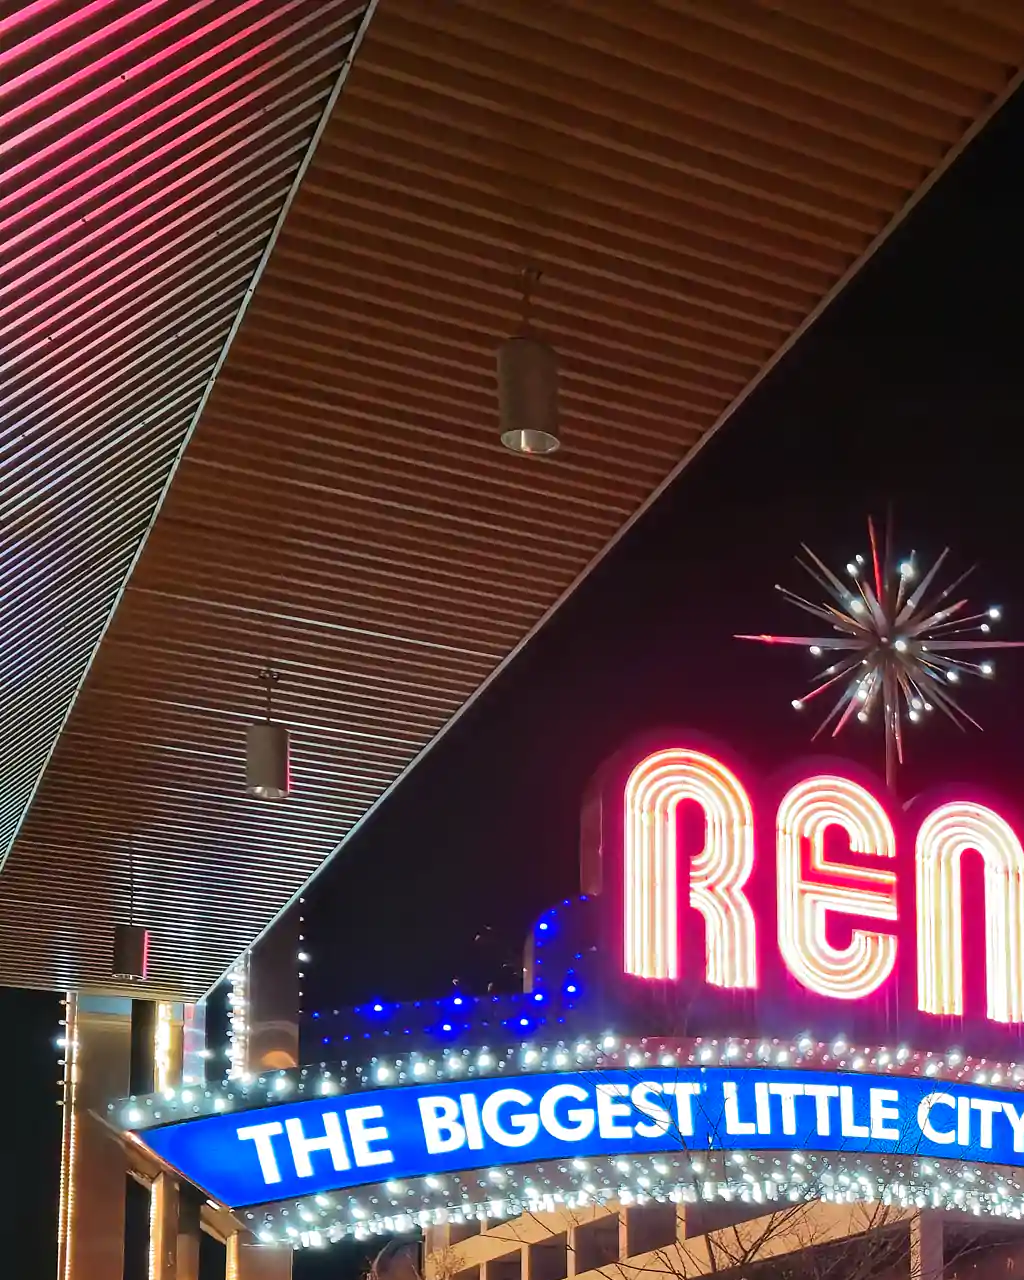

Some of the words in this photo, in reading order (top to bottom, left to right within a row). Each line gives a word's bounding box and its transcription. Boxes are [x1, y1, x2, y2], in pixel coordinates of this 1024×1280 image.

[237, 1105, 394, 1185] THE
[417, 1082, 702, 1154] BIGGEST
[723, 1081, 900, 1141] LITTLE
